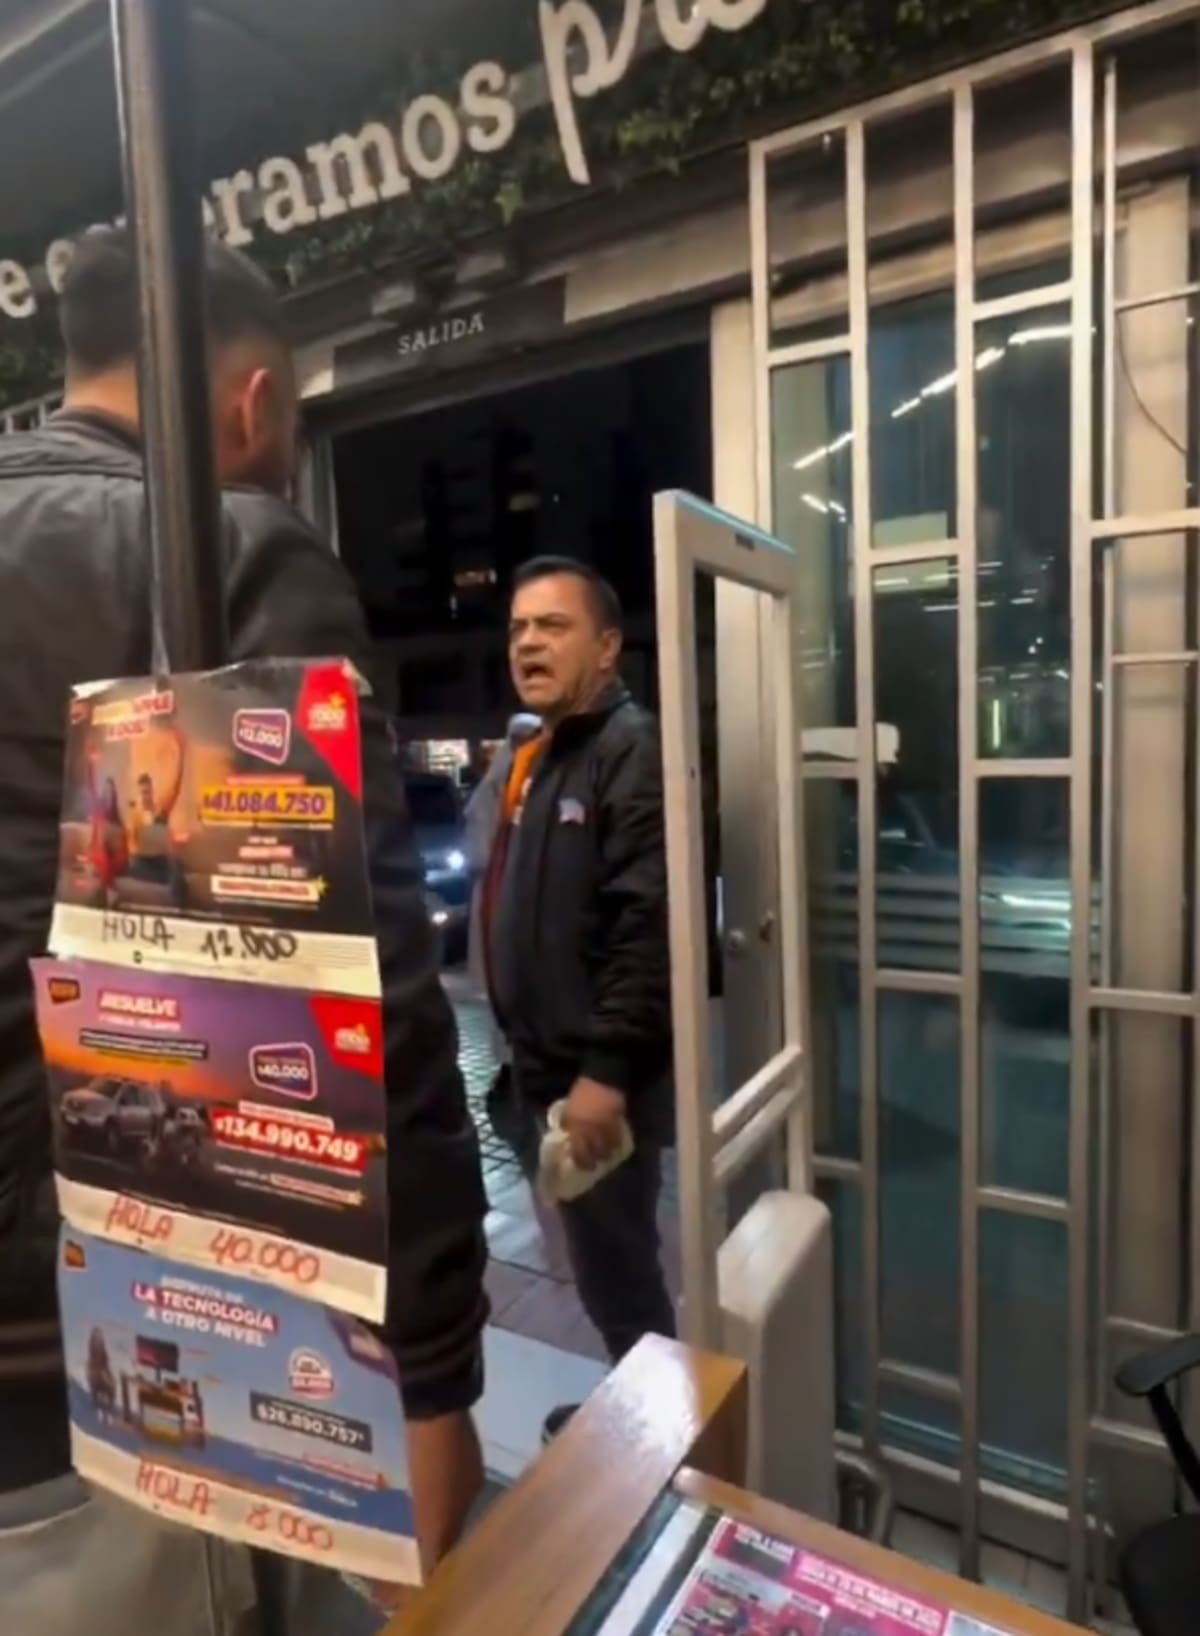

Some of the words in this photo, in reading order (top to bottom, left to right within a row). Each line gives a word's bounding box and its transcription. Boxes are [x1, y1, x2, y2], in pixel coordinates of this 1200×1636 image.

[397, 312, 485, 355] SALIDA
[102, 910, 175, 952] HOLA
[104, 1196, 174, 1241] HOLA
[134, 1282, 157, 1302] LA
[161, 1290, 275, 1332] TECNOLOGÍA
[144, 1306, 157, 1321] A
[161, 1309, 210, 1333] OTRO
[214, 1319, 268, 1348] NIVEL
[136, 1459, 210, 1515] HOLA
